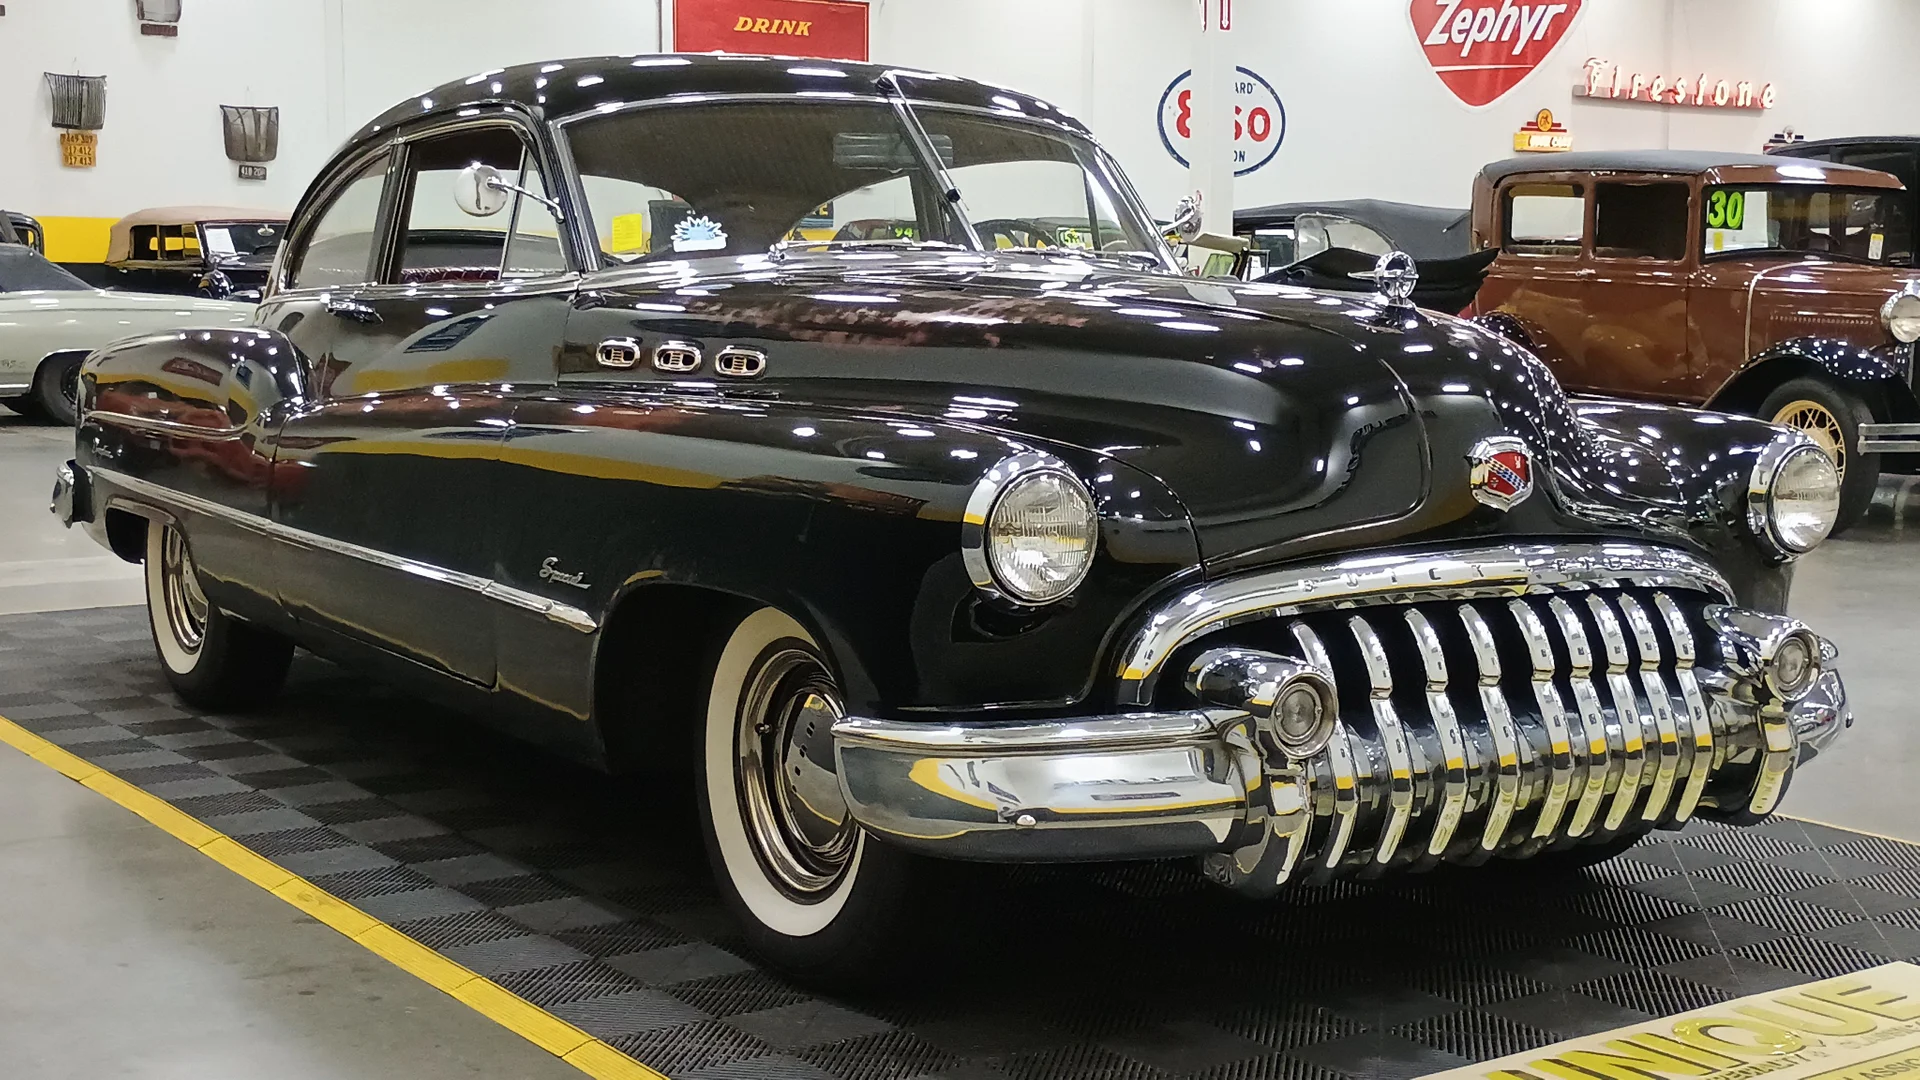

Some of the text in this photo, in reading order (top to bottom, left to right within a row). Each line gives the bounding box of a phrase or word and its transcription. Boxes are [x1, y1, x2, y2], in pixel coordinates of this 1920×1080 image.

[733, 15, 813, 36] DRINK
[1423, 0, 1568, 58] Zephyr
[1582, 56, 1777, 110] Firestone
[1709, 190, 1744, 229] 30
